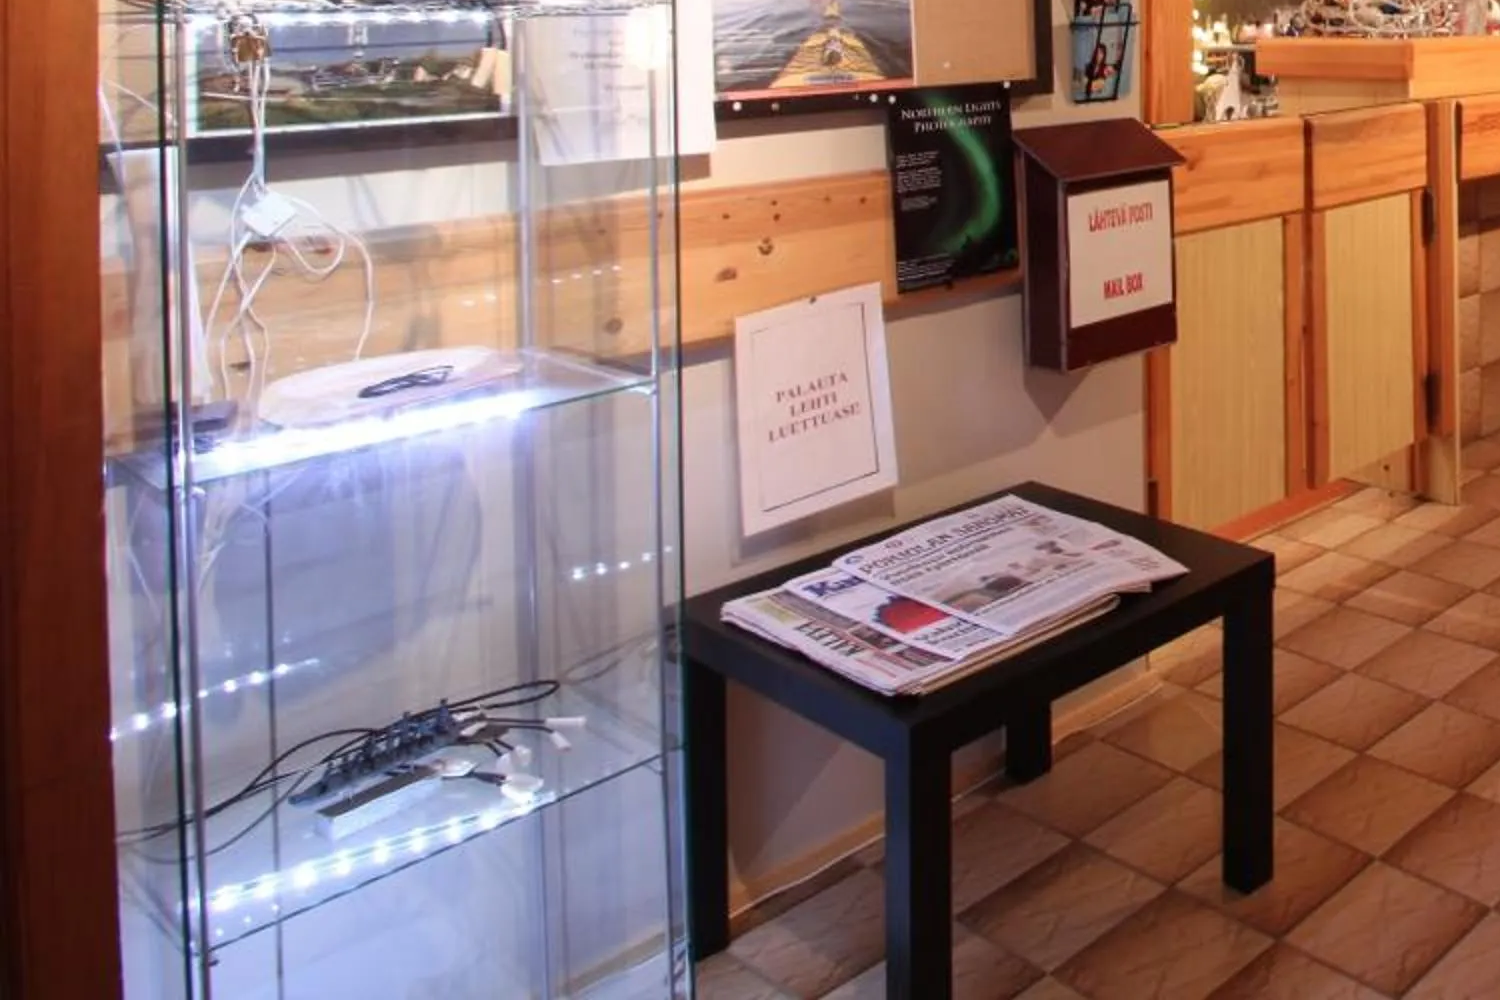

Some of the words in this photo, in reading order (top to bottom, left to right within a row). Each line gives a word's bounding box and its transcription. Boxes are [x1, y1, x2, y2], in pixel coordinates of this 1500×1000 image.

[1128, 201, 1154, 224] POSTI
[1103, 276, 1125, 300] MAIL
[1125, 271, 1143, 295] BOX
[776, 372, 848, 403] PALAUTA
[790, 391, 837, 418] LEHTI
